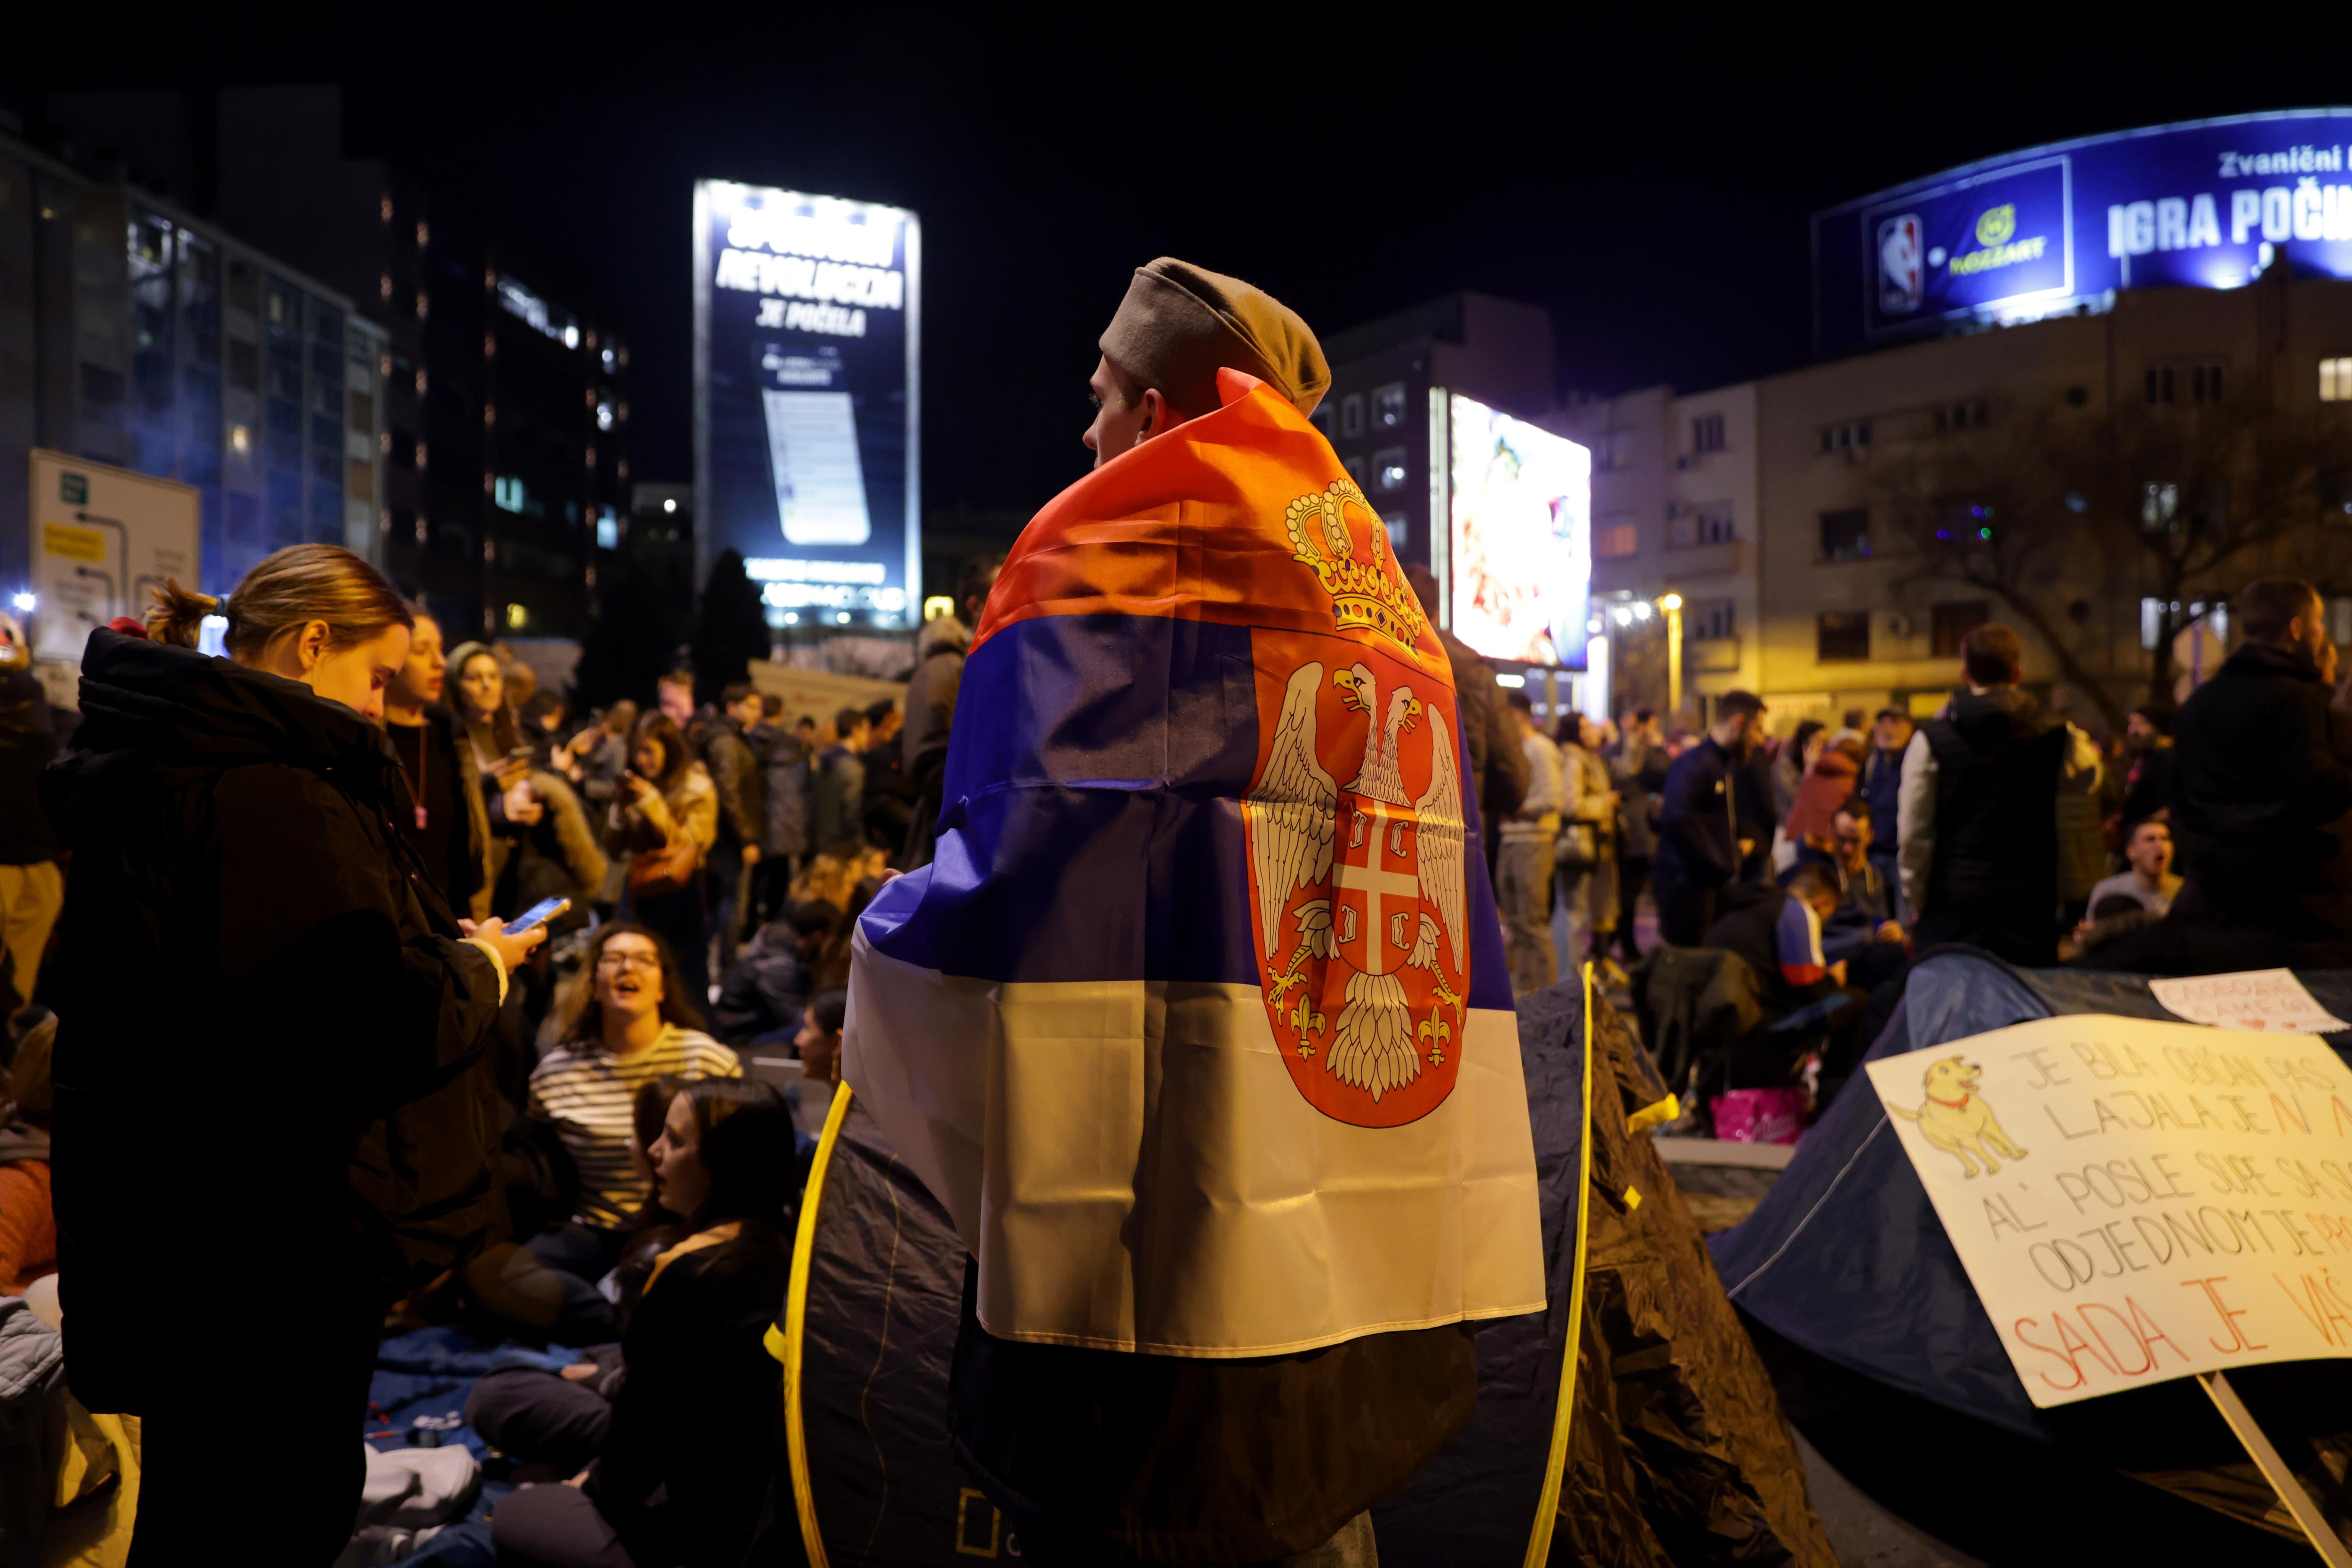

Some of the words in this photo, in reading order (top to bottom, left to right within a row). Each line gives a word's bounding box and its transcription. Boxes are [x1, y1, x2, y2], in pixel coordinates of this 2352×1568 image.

[2218, 144, 2343, 178] Zvanični
[2107, 192, 2222, 258] IGRA
[2009, 1046, 2072, 1090] JE
[2070, 1041, 2160, 1081] BILA
[2264, 1057, 2336, 1092] PAS
[2043, 1090, 2224, 1140] LAJALA
[2054, 1153, 2195, 1215] POSLE
[2195, 1151, 2281, 1197] SUPE
[2275, 1156, 2336, 1200] SA
[2028, 1205, 2277, 1293] ODJEDNOM
[2261, 1209, 2325, 1256] JE
[2014, 1295, 2191, 1391] SADA
[2180, 1276, 2268, 1355] JE
